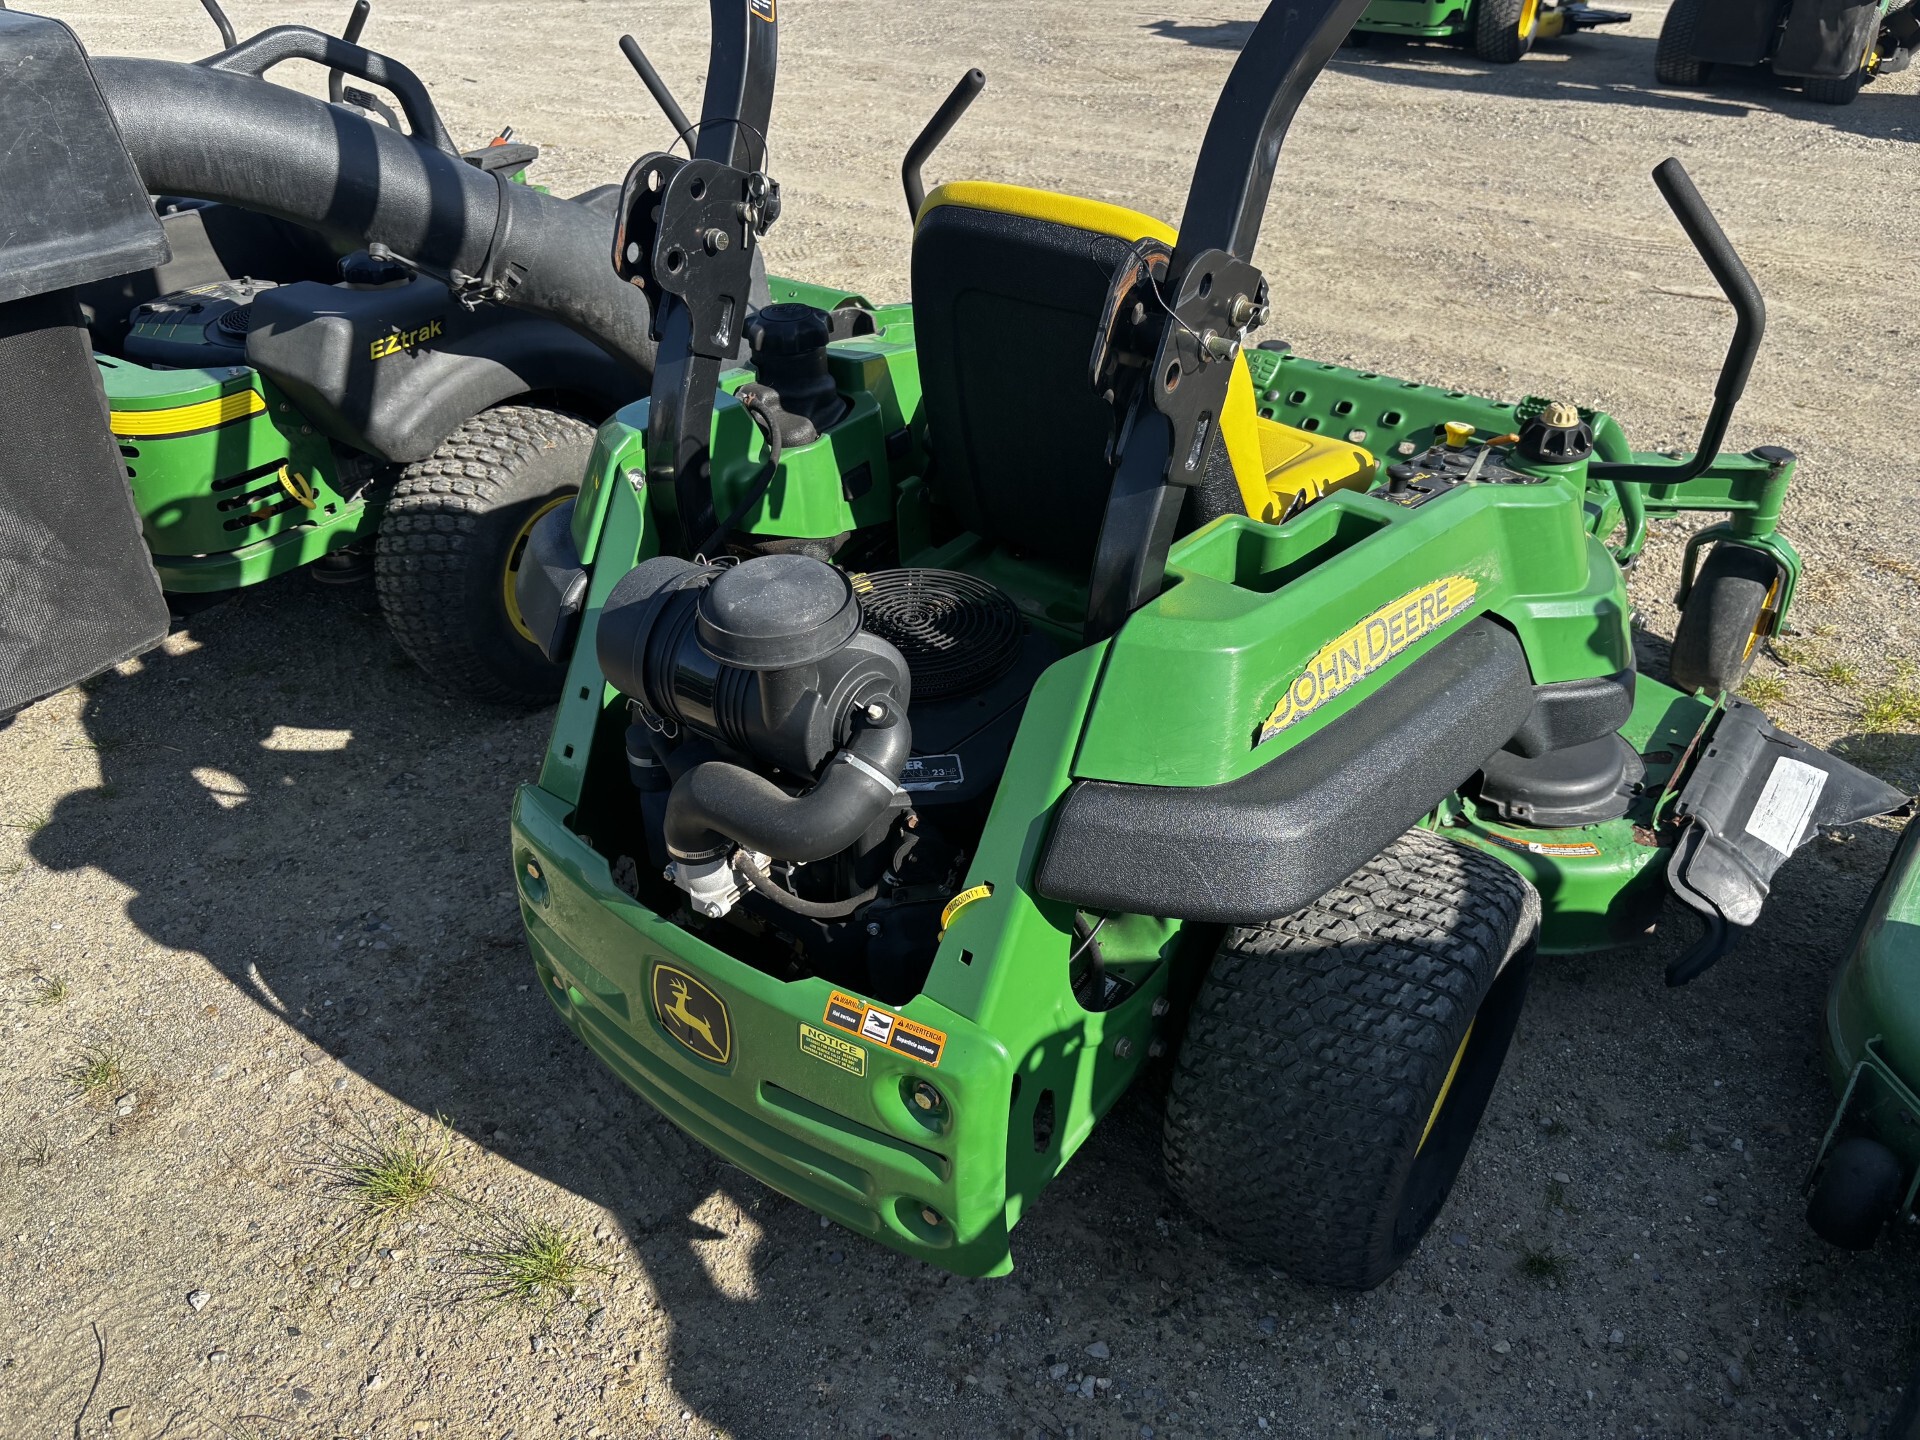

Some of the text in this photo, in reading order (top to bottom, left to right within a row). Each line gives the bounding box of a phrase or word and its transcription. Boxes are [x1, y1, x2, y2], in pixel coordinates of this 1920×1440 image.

[370, 320, 442, 360] EZtrak
[1273, 583, 1450, 725] JOHN DEERE
[807, 1028, 857, 1055] NOTICE
[905, 1022, 942, 1042] ADVERTENCIA
